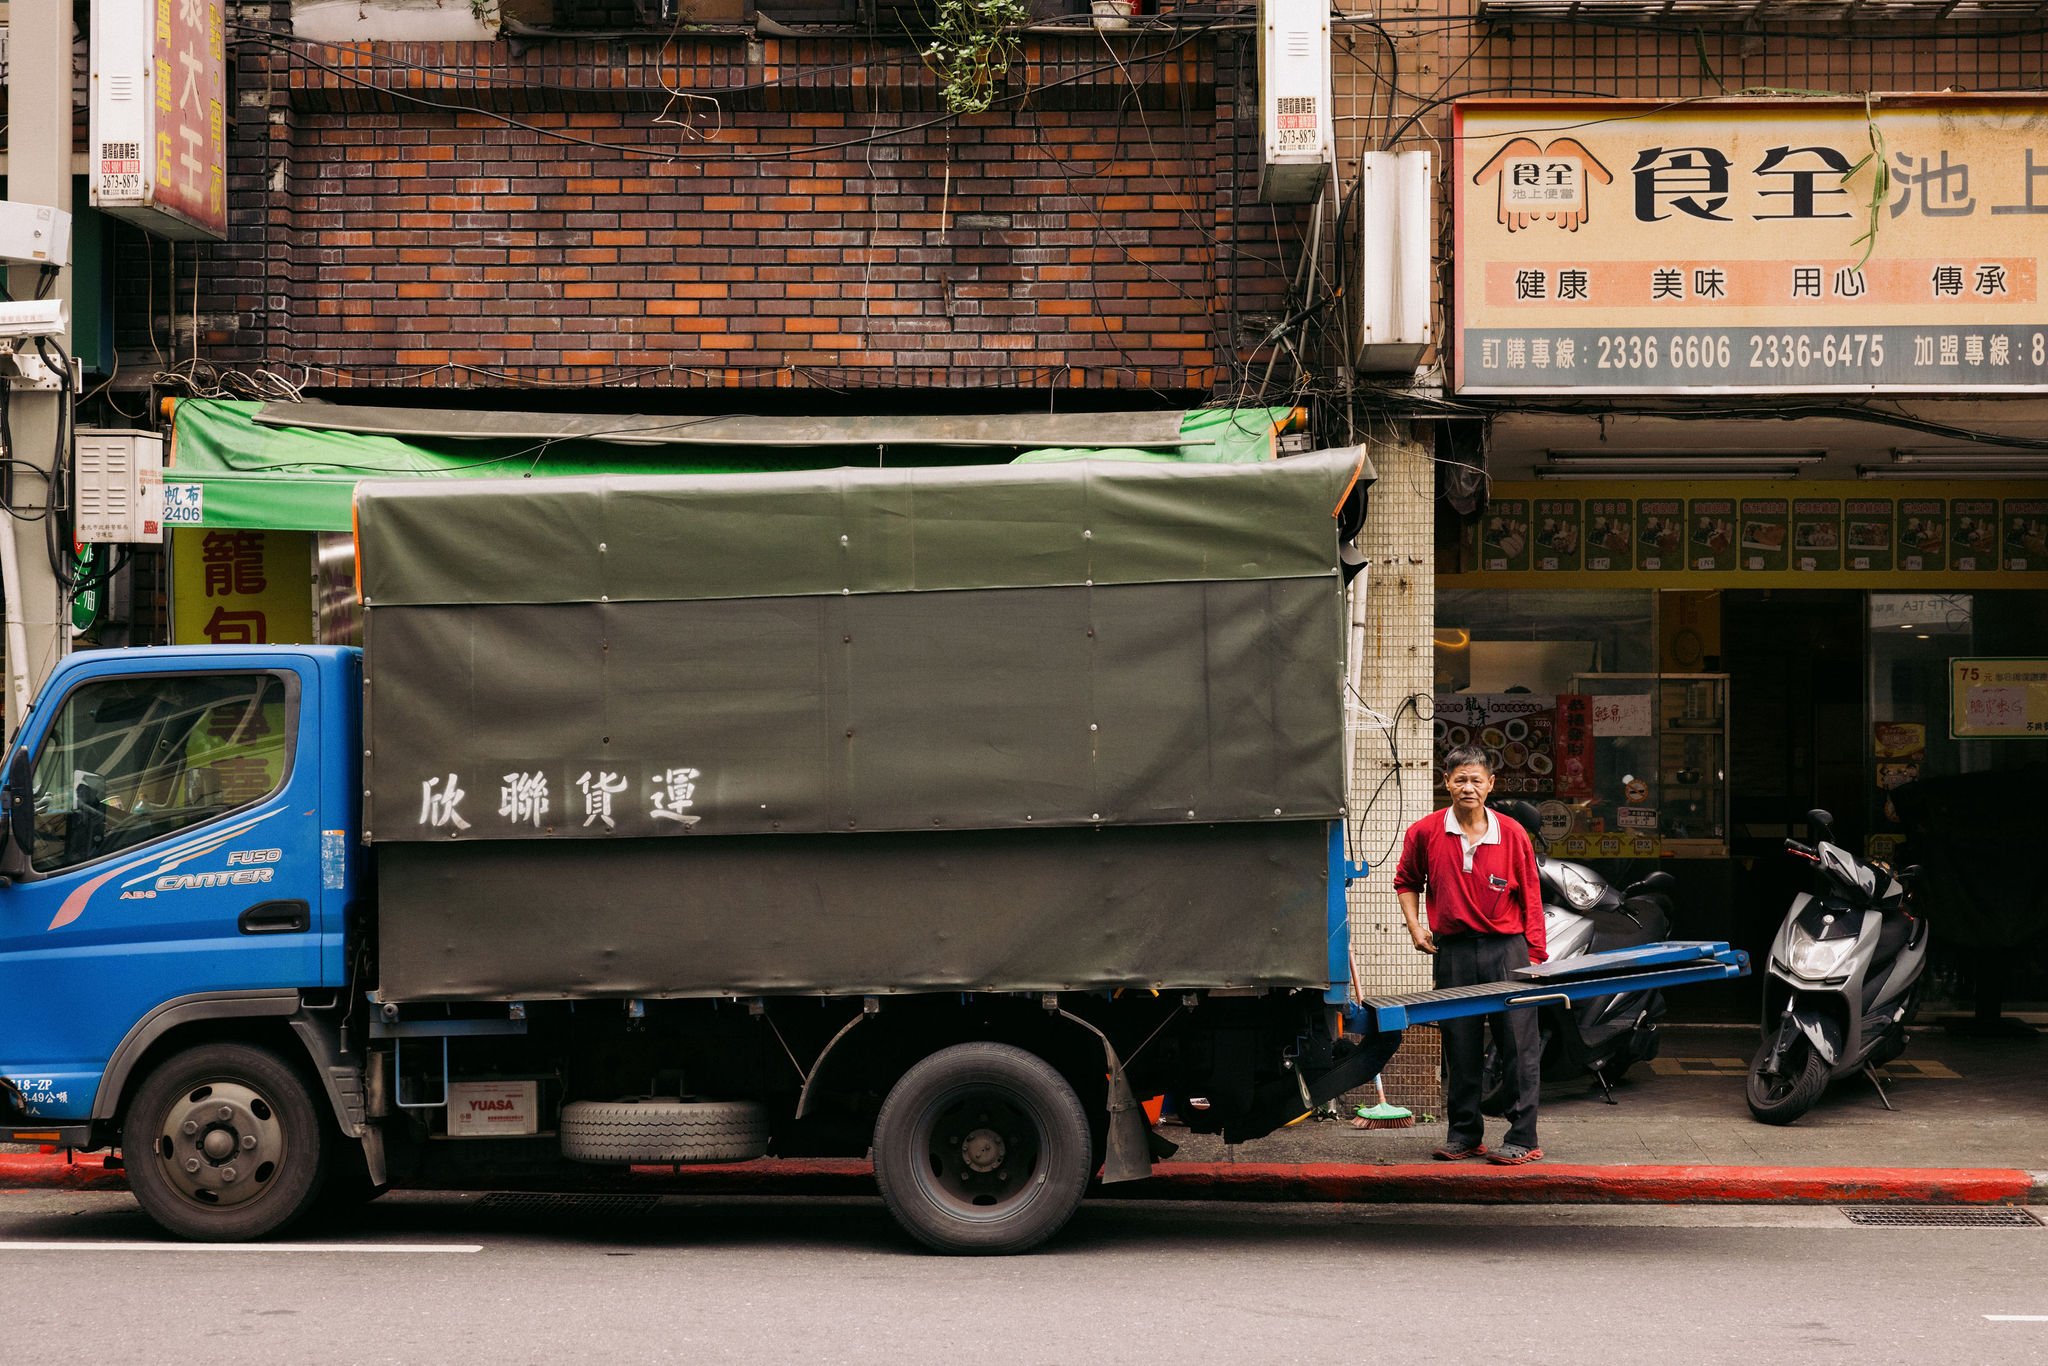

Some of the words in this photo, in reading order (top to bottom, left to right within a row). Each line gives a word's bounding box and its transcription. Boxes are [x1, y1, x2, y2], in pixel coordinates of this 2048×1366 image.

[1279, 130, 1316, 143] 2673-8879
[102, 175, 139, 188] 2673-8879
[1512, 162, 1574, 187] 食全
[1631, 146, 1855, 222] 食全
[1512, 188, 1575, 201] 池上便當
[1515, 268, 1589, 301] 健康
[1652, 268, 1726, 300] 美味
[1792, 266, 1866, 298] 用心
[1932, 264, 2007, 296] 傳承
[1597, 335, 1658, 369] 2336
[1670, 334, 1731, 369] 6606
[1749, 333, 1884, 368] 2336-6475
[164, 486, 201, 505] 帆布
[1960, 668, 1980, 681] 75
[420, 768, 701, 830] 欣聯貨運
[227, 848, 282, 867] FUSO
[155, 868, 274, 891] CANTER
[469, 1100, 513, 1111] YUASA
